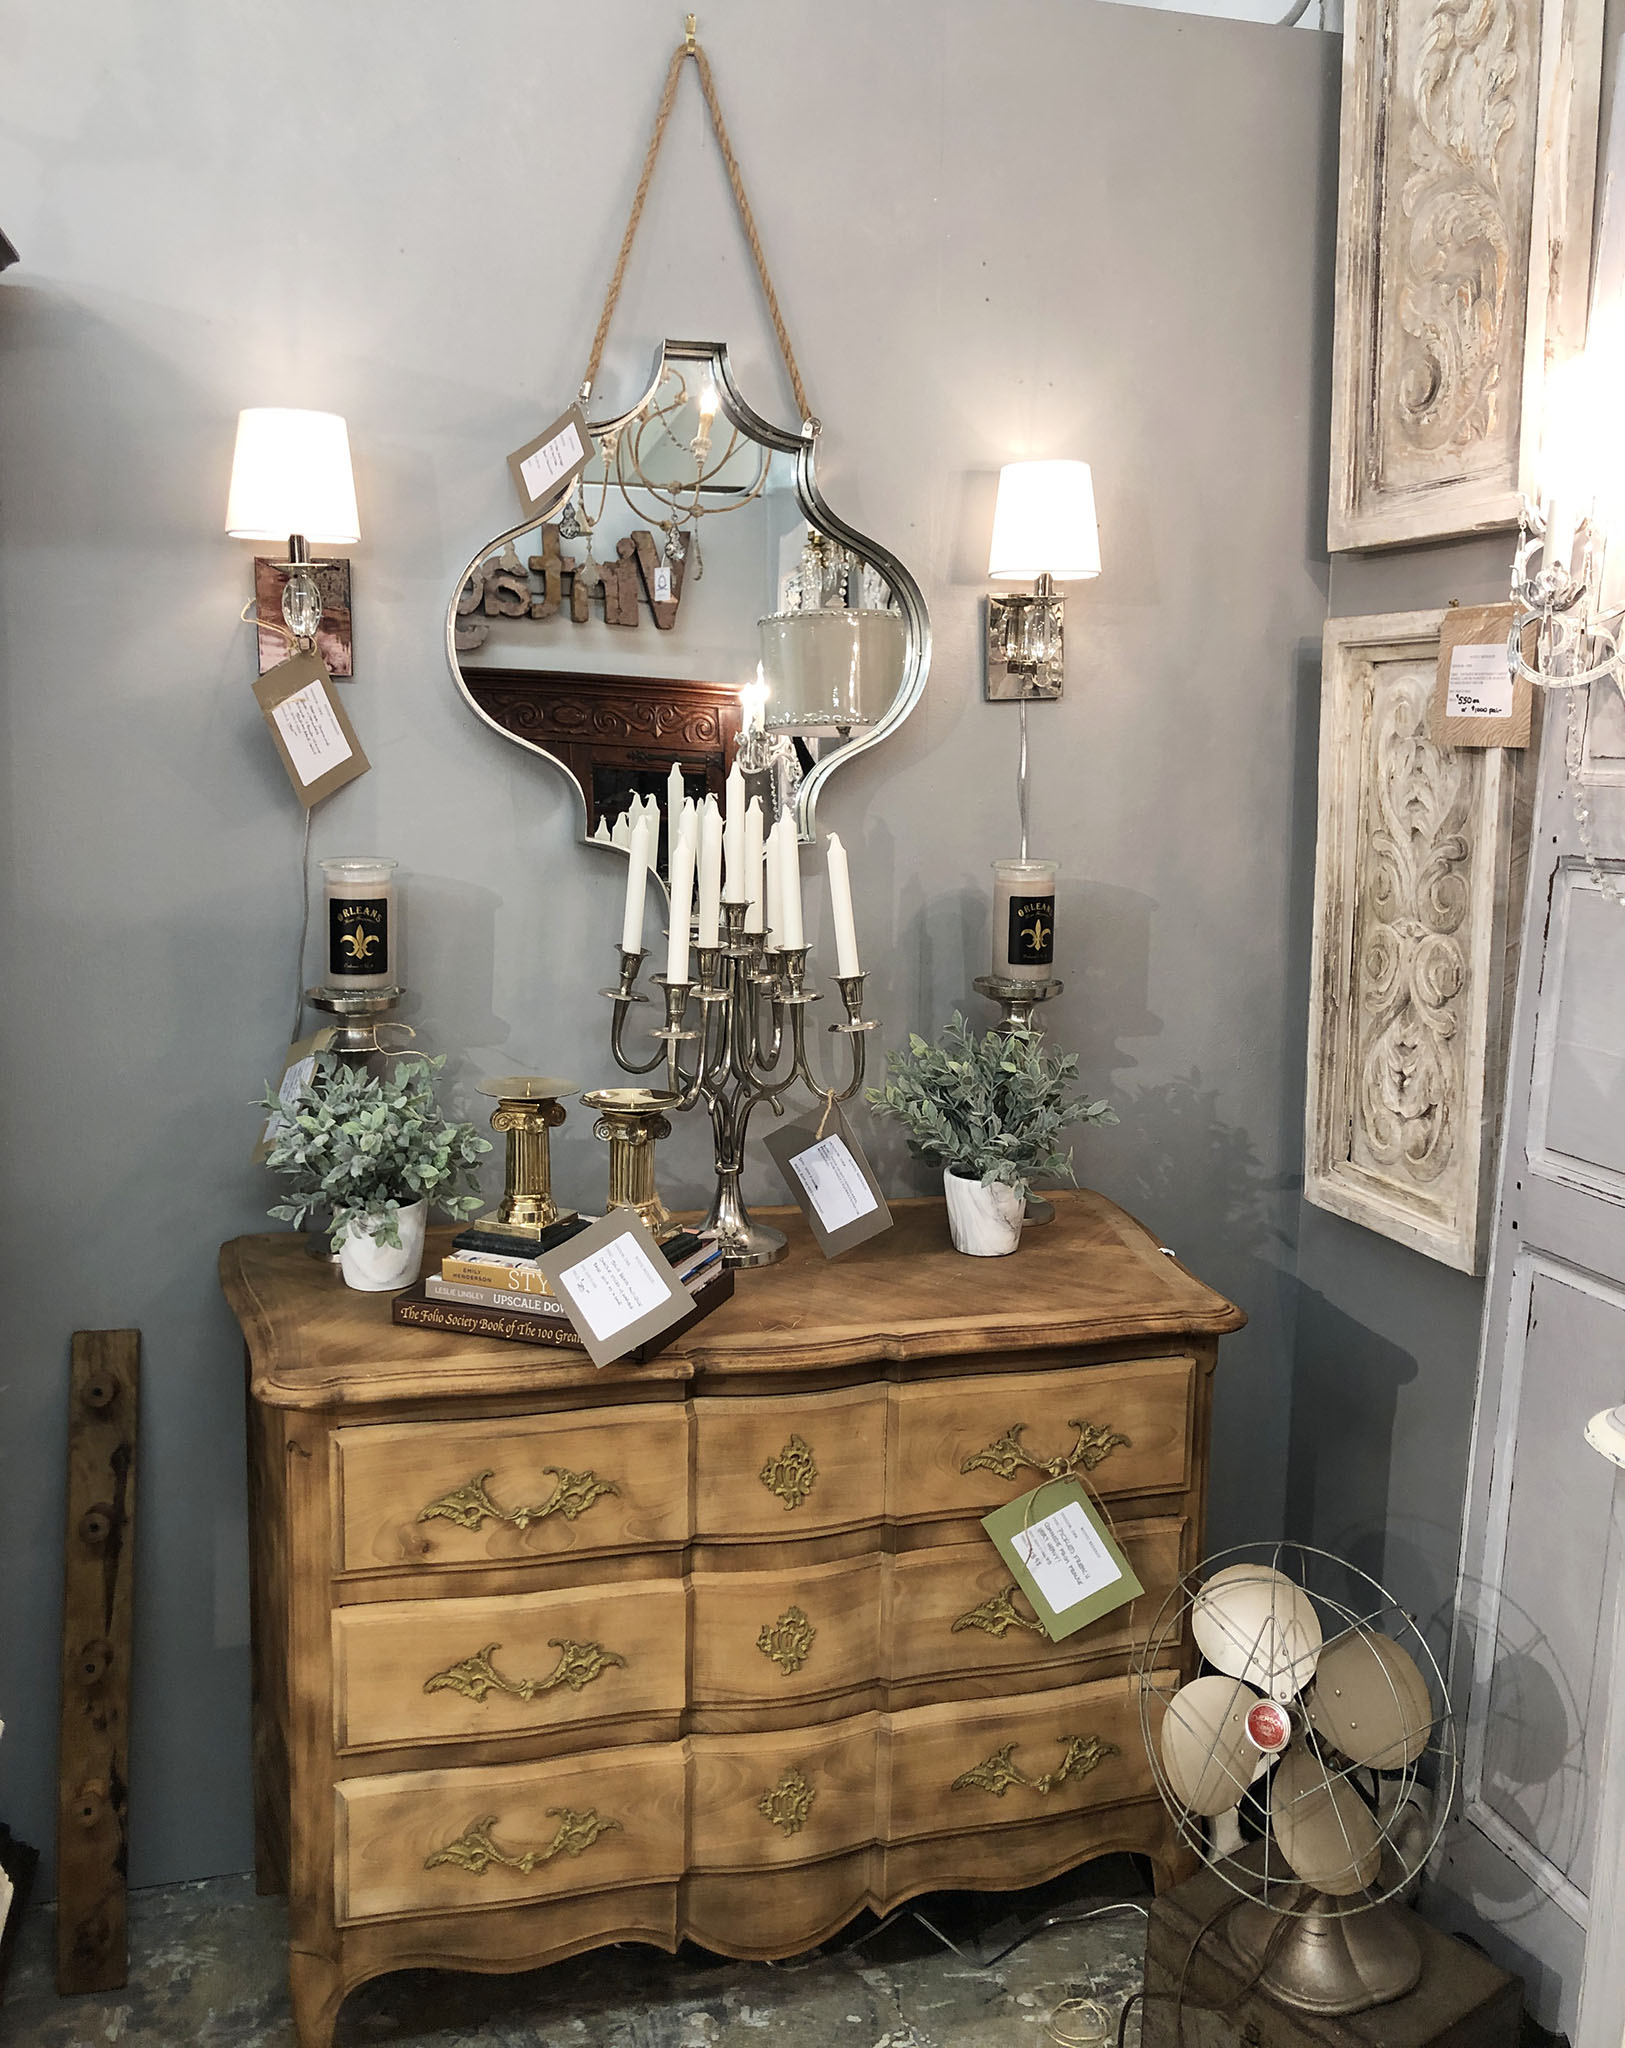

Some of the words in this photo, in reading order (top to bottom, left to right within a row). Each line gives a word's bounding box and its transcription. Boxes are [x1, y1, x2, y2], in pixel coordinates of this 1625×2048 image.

[337, 906, 383, 923] ORLEANS
[452, 1273, 492, 1283] HENDERSON
[462, 1267, 481, 1275] EMILY
[508, 1270, 556, 1296] STY
[434, 1286, 457, 1297] LESLIE
[457, 1289, 484, 1300] LINSLEY
[493, 1294, 541, 1310] UPSCALE
[400, 1305, 419, 1320] The
[420, 1308, 445, 1322] Folio
[444, 1313, 478, 1332] Society
[479, 1317, 505, 1333] Book
[505, 1319, 518, 1338] of
[517, 1321, 537, 1337] The
[538, 1328, 553, 1340] 100
